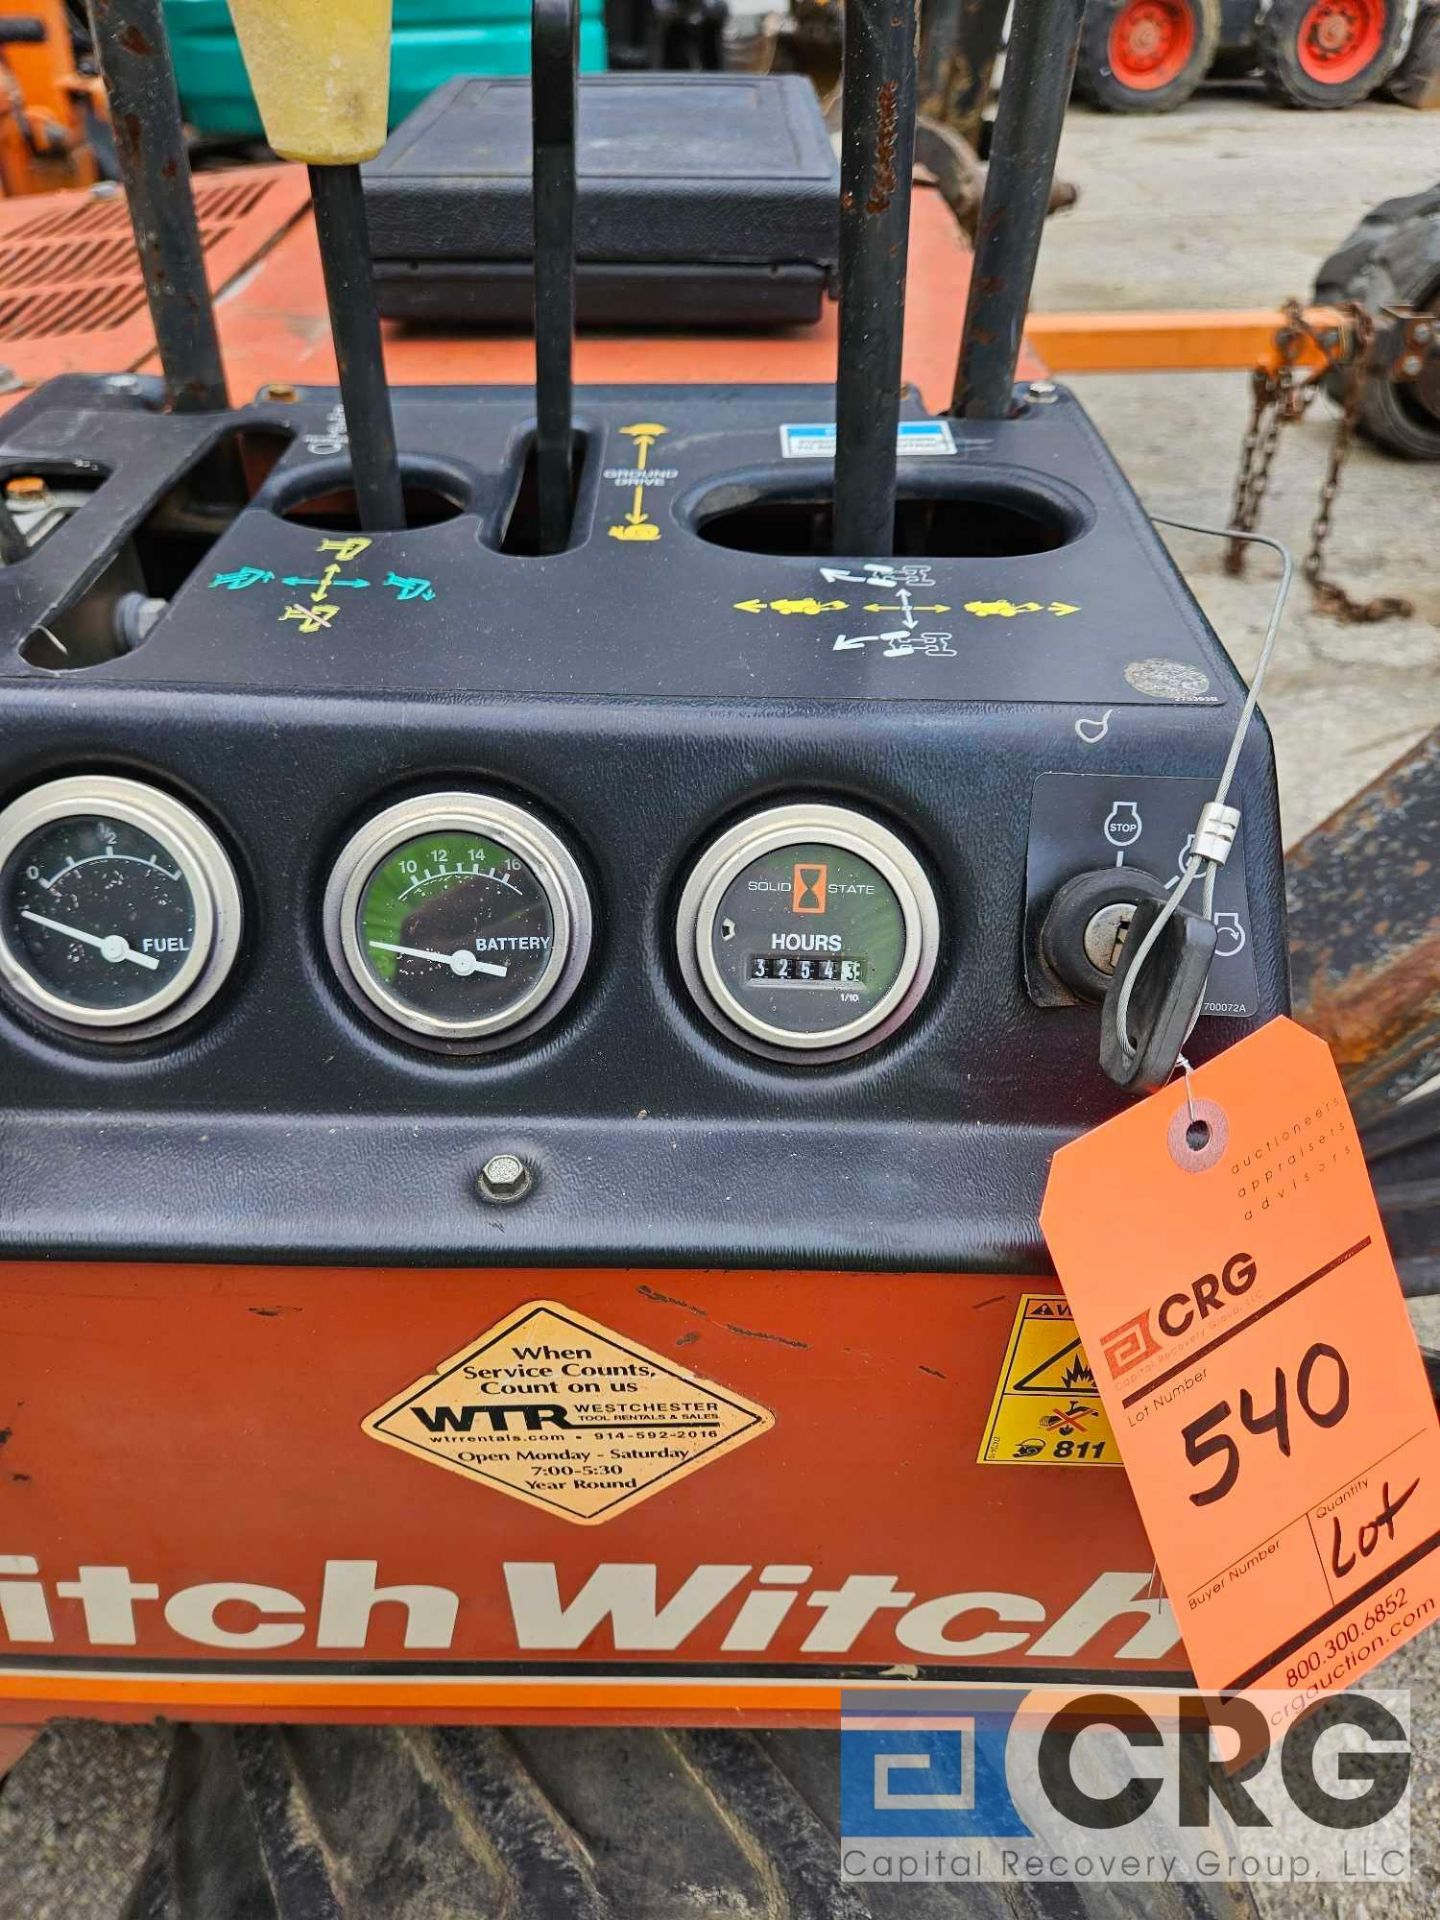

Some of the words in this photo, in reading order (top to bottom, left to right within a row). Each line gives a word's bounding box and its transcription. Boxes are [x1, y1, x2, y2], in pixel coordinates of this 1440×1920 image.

[603, 468, 679, 479] GROUND
[614, 478, 665, 487] DRIVE
[1110, 823, 1137, 832] STOP
[398, 860, 418, 874] 10
[431, 849, 449, 863] 12
[467, 849, 486, 861] 14
[504, 858, 522, 871] 16
[748, 881, 792, 892] SOLID
[827, 883, 876, 895] STATE
[142, 937, 190, 952] FUEL
[475, 936, 551, 951] BATTERY
[771, 933, 842, 952] HOURS
[840, 993, 860, 1003] 1/10
[1203, 1002, 1247, 1013] 700072A
[1231, 1097, 1339, 1175] auctioneers
[1238, 1122, 1345, 1198] appraisers
[1244, 1144, 1351, 1221] advisors
[1158, 1252, 1257, 1337] CRG
[512, 1345, 592, 1361] When
[463, 1364, 553, 1380] Service
[561, 1363, 656, 1378] Counts,
[480, 1381, 560, 1395] Count
[568, 1382, 600, 1393] on
[610, 1382, 639, 1393] us
[1127, 1405, 1150, 1428] Lot
[1153, 1366, 1208, 1411] Number
[574, 1402, 718, 1413] WESTCHESTER
[410, 1404, 571, 1432] WTR
[613, 1413, 666, 1421] RENTALS
[681, 1412, 719, 1420] SALES
[1181, 1342, 1350, 1507] 540
[430, 1433, 565, 1443] wtrrentals.com
[594, 1430, 718, 1440] 914-592-2016
[457, 1450, 510, 1464] Open
[516, 1449, 591, 1463] Monday
[610, 1447, 689, 1461] Saturday
[1053, 1440, 1107, 1459] 811
[530, 1465, 623, 1476] 7:00-5:30
[525, 1479, 567, 1490] Year
[573, 1478, 638, 1489] Round
[1315, 1477, 1369, 1519] Quantity
[1331, 1477, 1420, 1578] Lot
[1188, 1578, 1226, 1611] Buyer
[1229, 1539, 1281, 1583] Number
[502, 1561, 1182, 1659] Witch
[1286, 1587, 1406, 1689] 800.300.6852
[1270, 1596, 1436, 1728] crgauction.com
